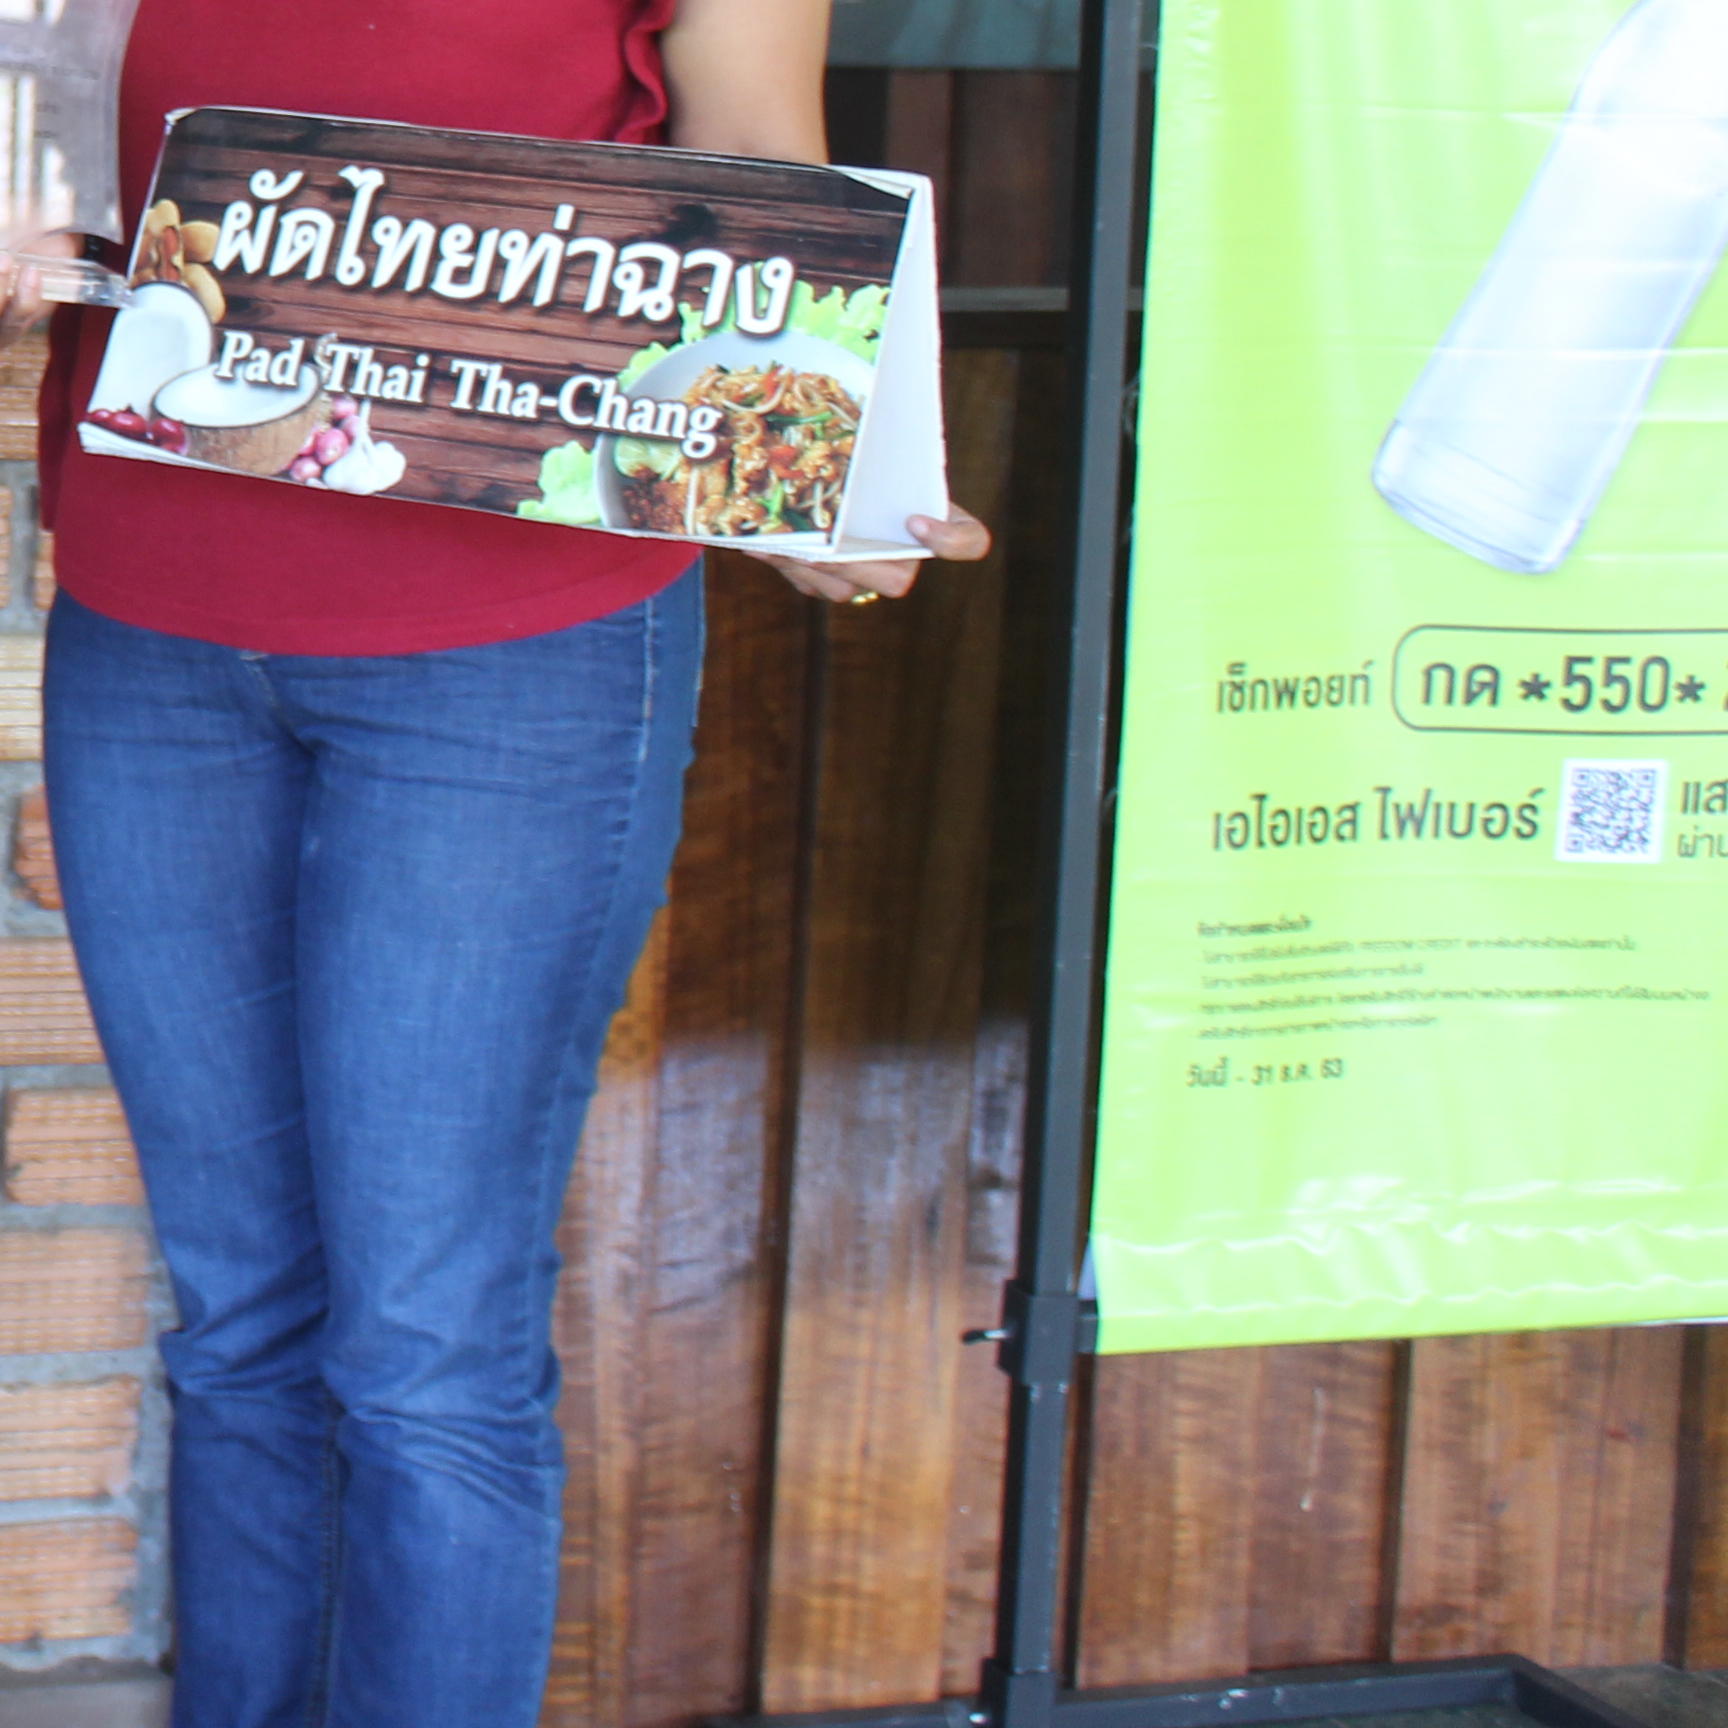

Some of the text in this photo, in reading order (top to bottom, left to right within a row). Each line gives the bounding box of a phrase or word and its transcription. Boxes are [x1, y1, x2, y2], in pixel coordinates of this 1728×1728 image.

[213, 165, 796, 336] ผัดไทยท่าฉาง
[215, 329, 724, 461] Pad Thai Tha-Chang
[1420, 660, 1502, 707] กด
[1212, 792, 1361, 851] เอไอเอส
[1374, 786, 1547, 843] ไฟเบอร์
